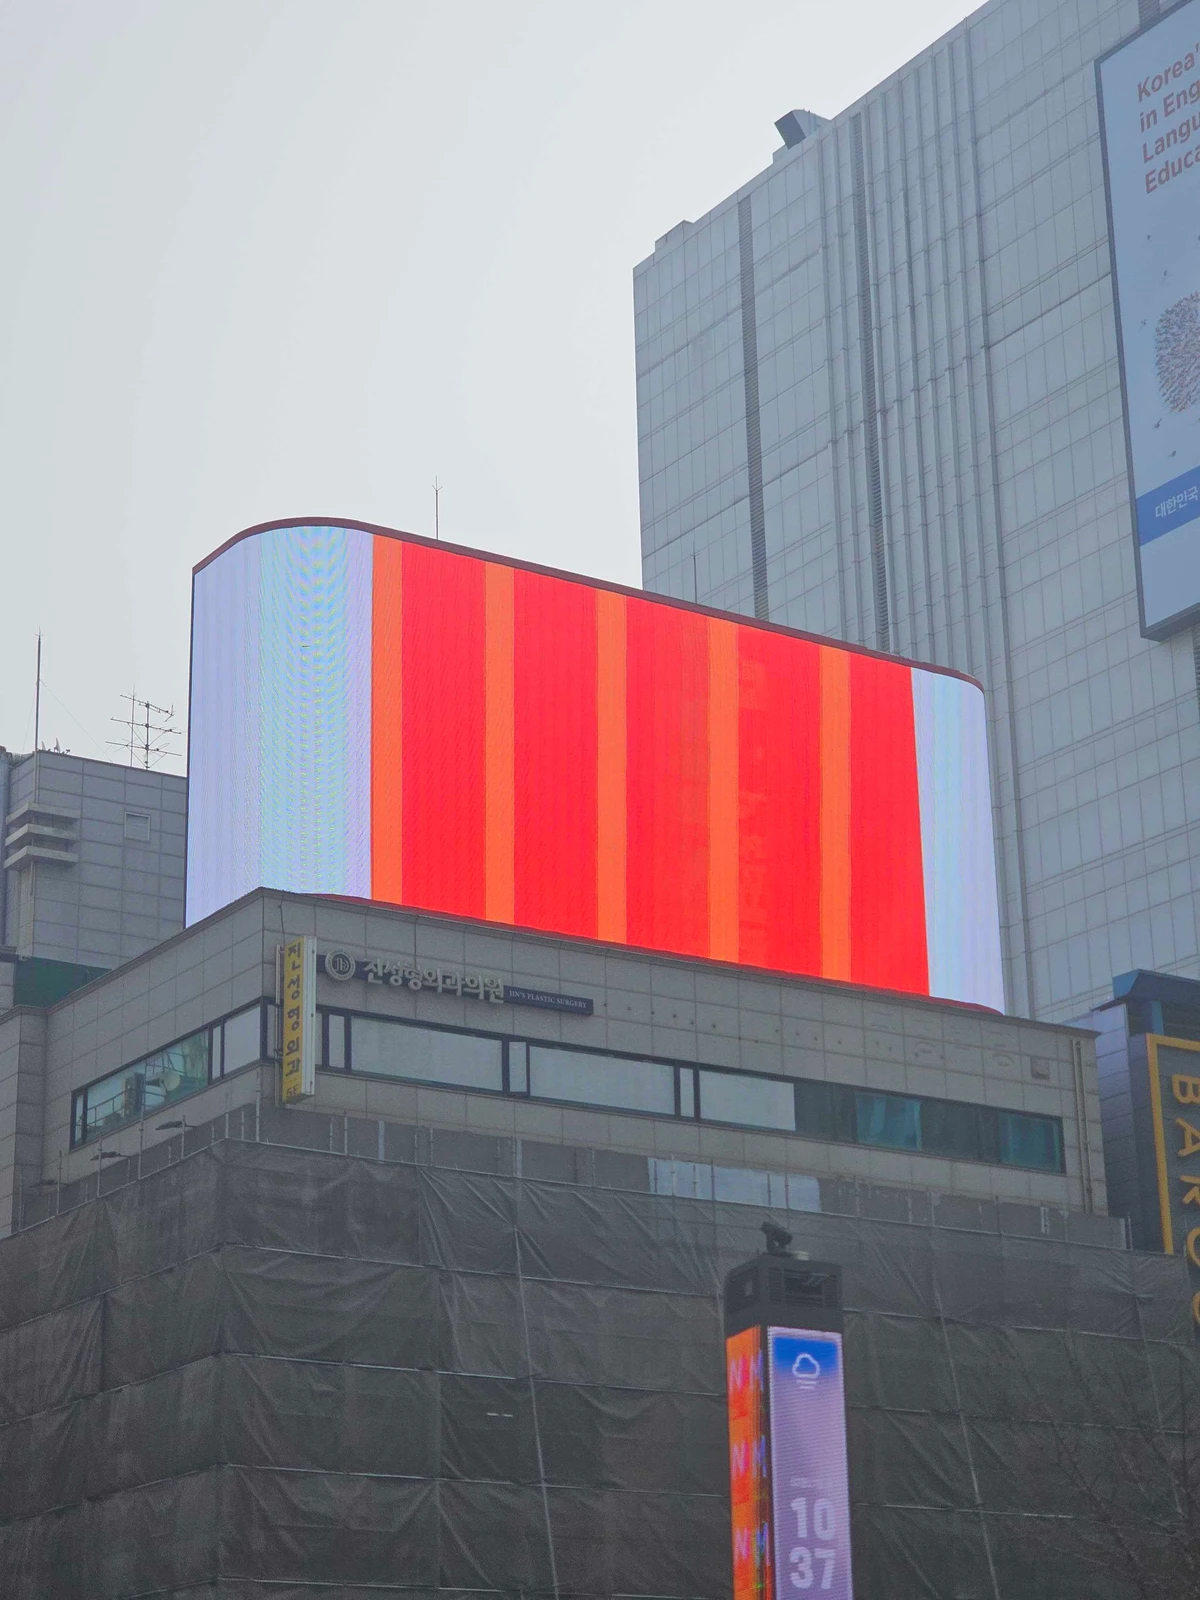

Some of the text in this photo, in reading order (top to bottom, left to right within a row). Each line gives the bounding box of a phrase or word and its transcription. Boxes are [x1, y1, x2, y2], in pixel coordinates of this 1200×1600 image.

[1140, 109, 1158, 133] in
[1155, 485, 1199, 518] 대한민국
[364, 958, 504, 1004] 진성형외과의원
[527, 992, 556, 1004] PLASTIC
[556, 998, 587, 1009] SURGERY
[287, 942, 301, 1078] 진성형외과
[790, 1497, 836, 1540] 10
[789, 1546, 836, 1590] 37
